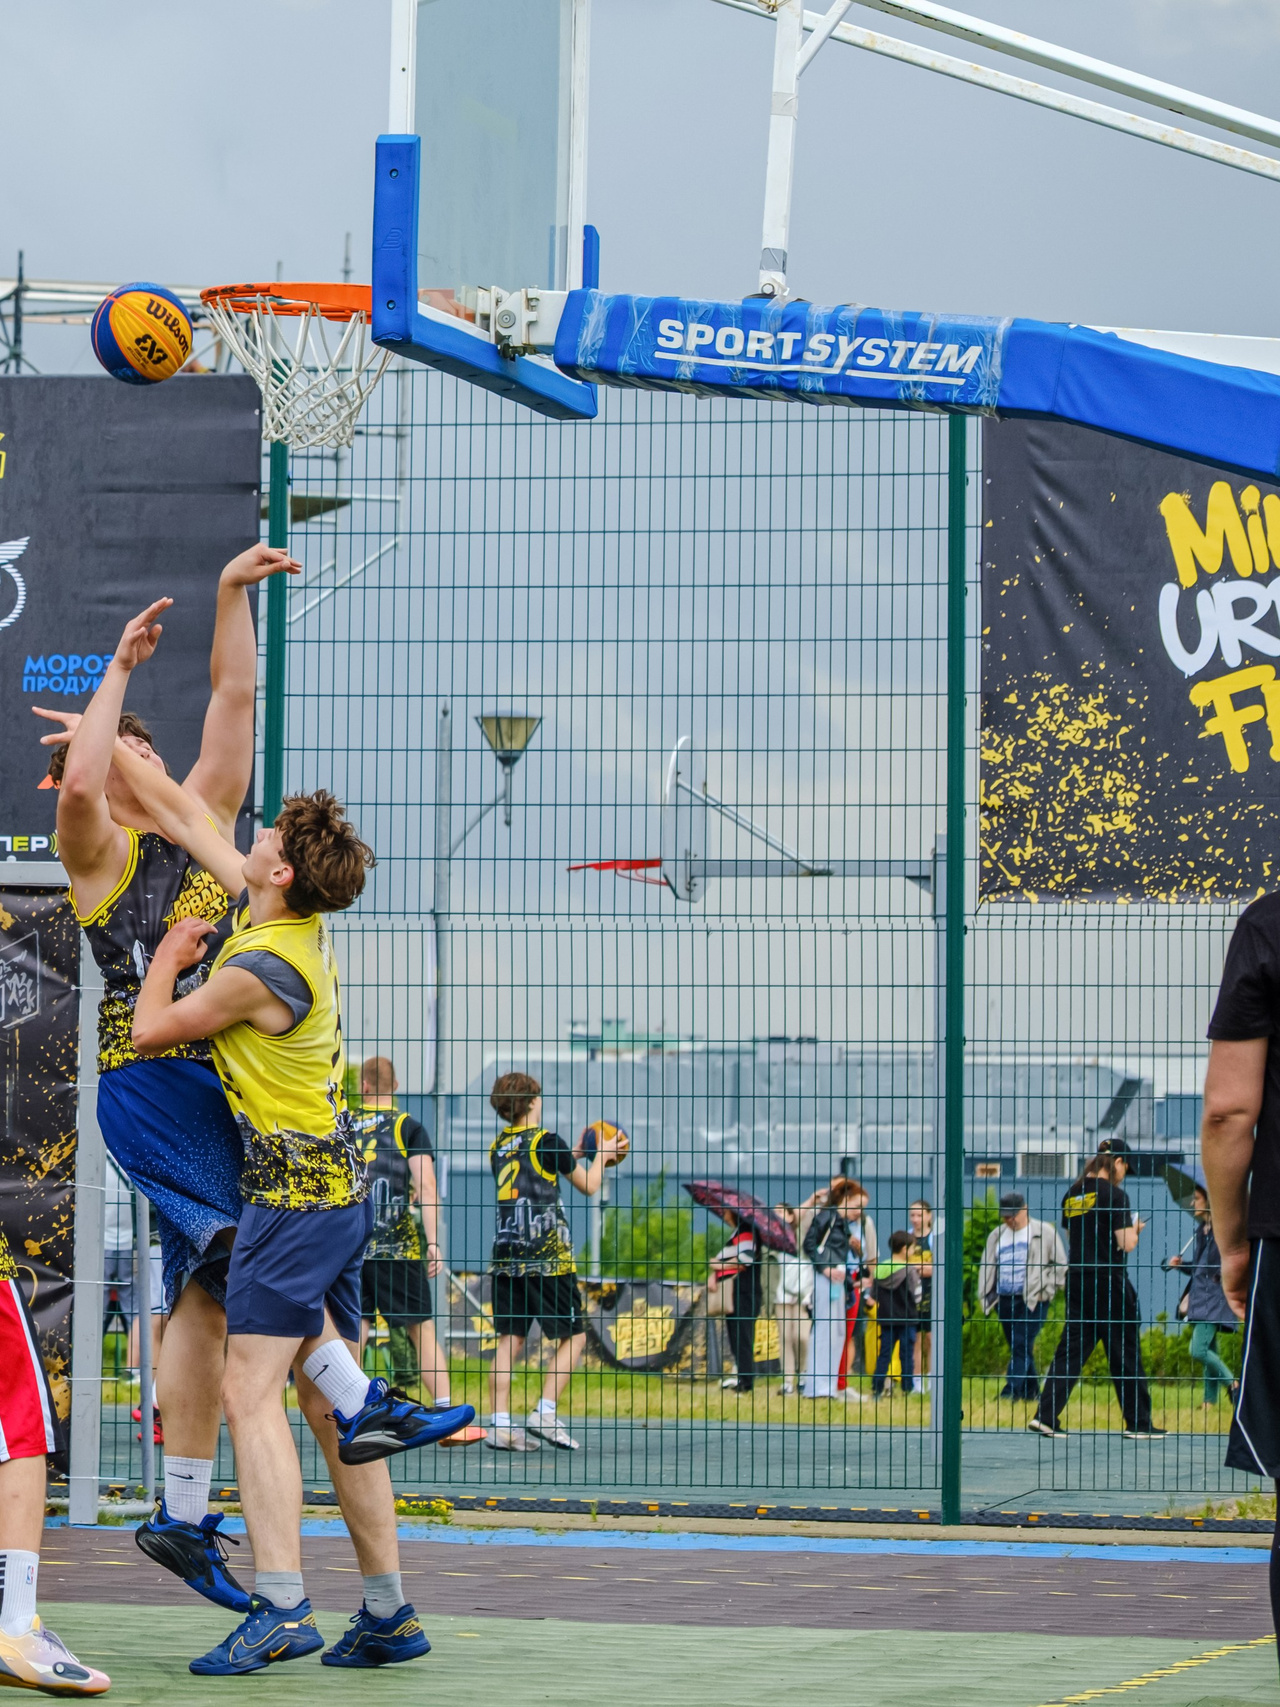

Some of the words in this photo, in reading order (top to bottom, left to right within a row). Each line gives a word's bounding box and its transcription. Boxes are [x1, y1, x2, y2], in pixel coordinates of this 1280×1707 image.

[145, 297, 190, 358] Wilson
[657, 319, 802, 360] SPORT
[803, 333, 983, 375] SYSTEM
[1159, 577, 1280, 676] UR
[497, 1159, 520, 1201] 2
